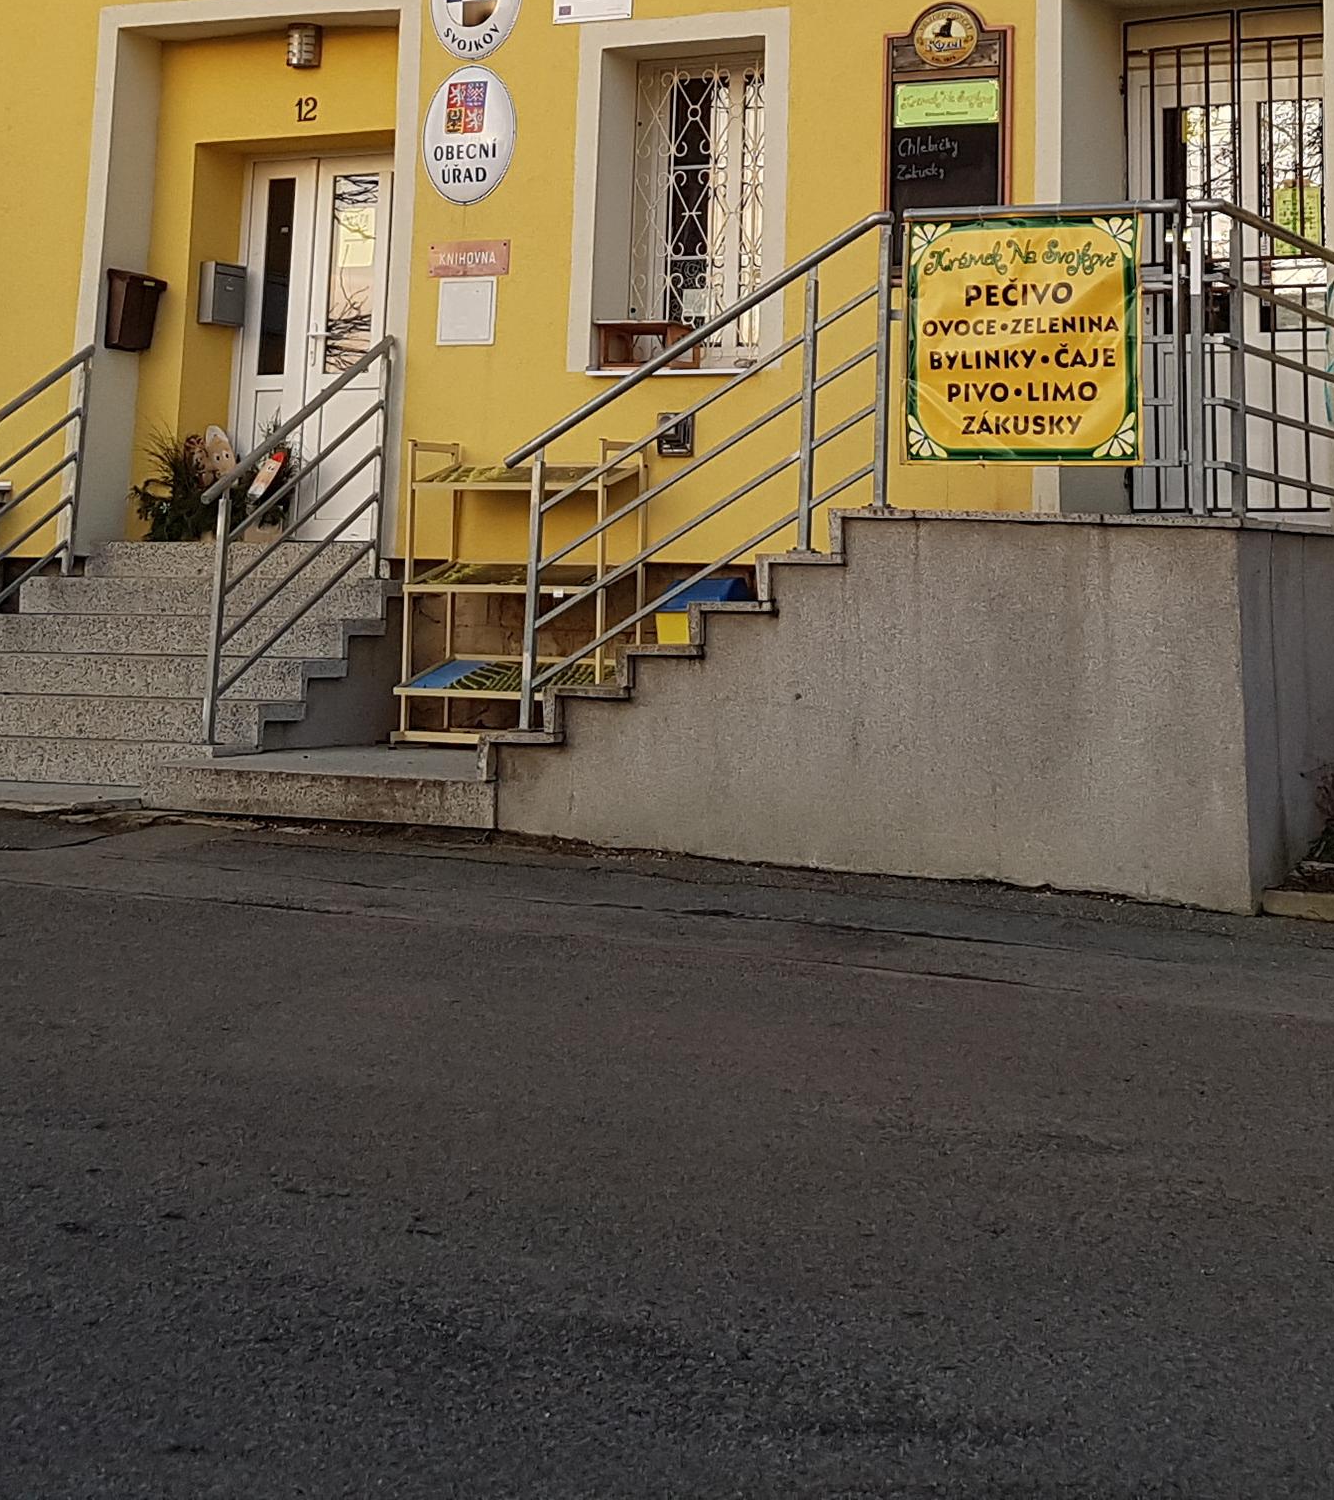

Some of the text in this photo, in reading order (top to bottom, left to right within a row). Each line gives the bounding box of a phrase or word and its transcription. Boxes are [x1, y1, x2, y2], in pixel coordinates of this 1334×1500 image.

[443, 24, 501, 52] SVOJKOV
[295, 97, 318, 122] 12
[434, 138, 497, 161] OBECNÍ
[441, 164, 488, 184] ÚŘAD
[439, 252, 496, 265] KNIHOVNA
[924, 239, 1118, 276] Krámek Na Svojkově
[965, 278, 1073, 307] PEČIVO
[961, 411, 1083, 435] ZÁKUSKY
